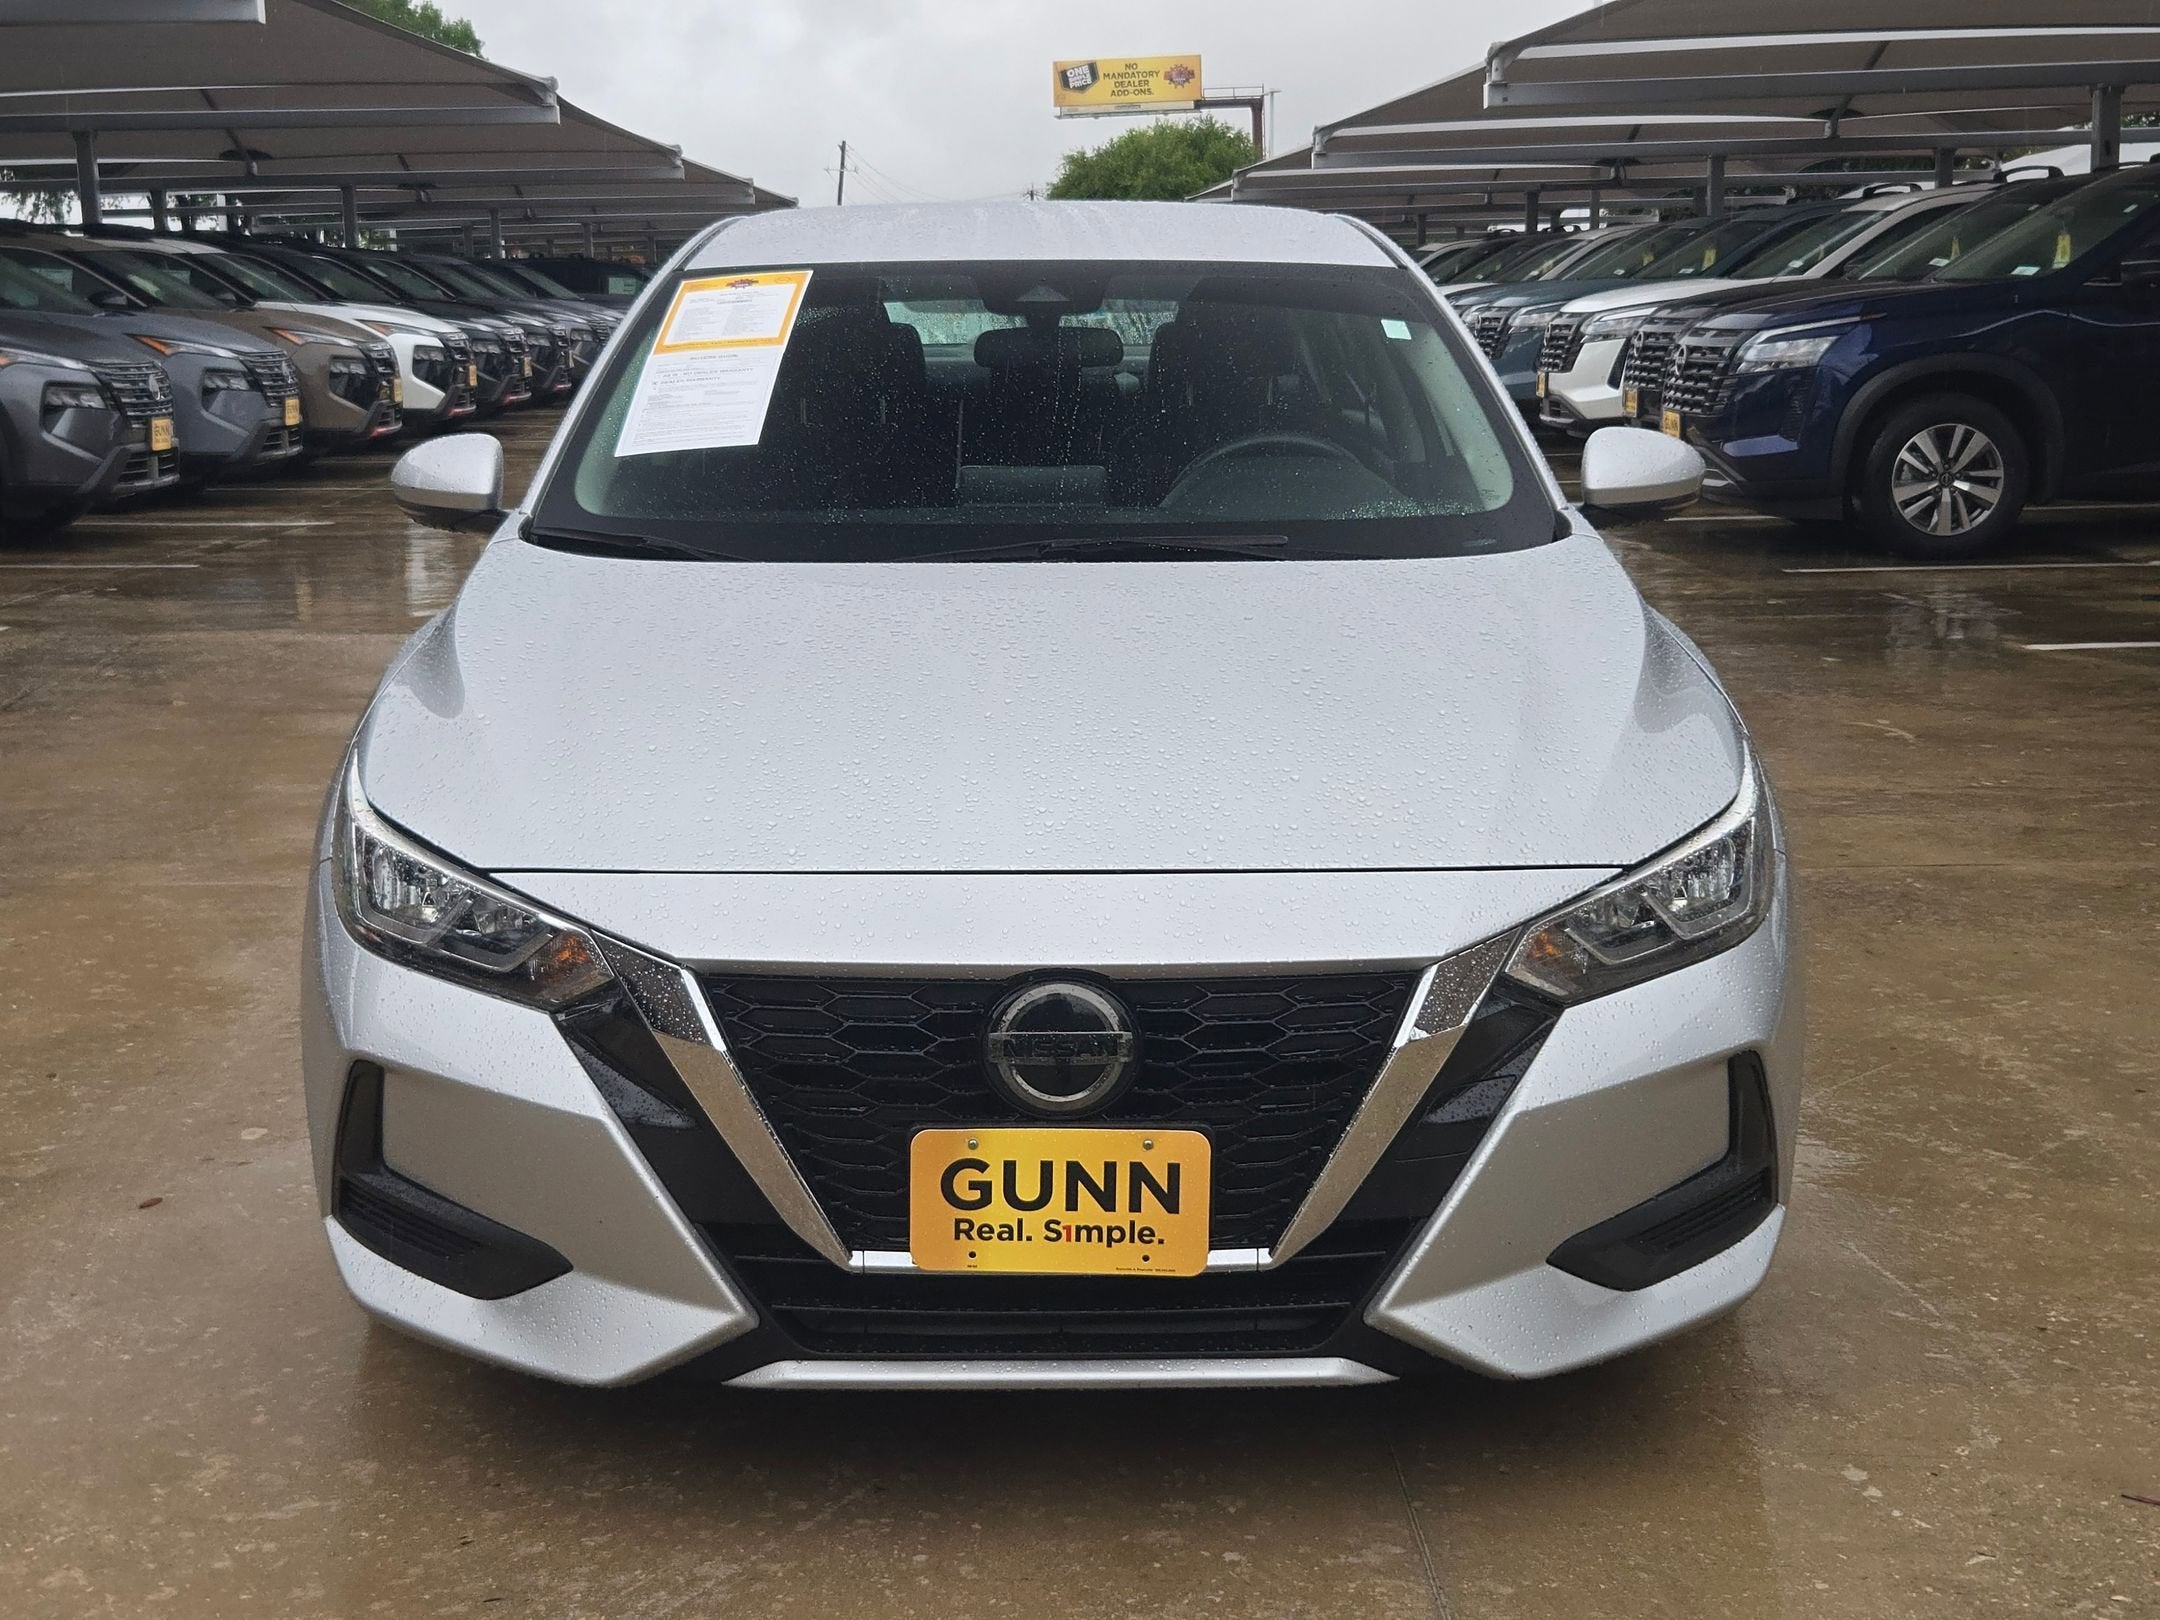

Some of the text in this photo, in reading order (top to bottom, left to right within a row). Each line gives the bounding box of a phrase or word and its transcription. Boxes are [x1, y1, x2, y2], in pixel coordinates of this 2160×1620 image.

[1067, 65, 1090, 77] ONE
[1125, 63, 1138, 71] NO
[1103, 70, 1160, 80] MANDATORY
[1069, 79, 1092, 89] PRICE
[1114, 79, 1150, 88] DEALER
[1110, 88, 1154, 97] ADD-ONS.
[1004, 1038, 1117, 1057] NISSAN
[941, 1158, 1181, 1214] GUNN
[954, 1218, 1033, 1242] Real.
